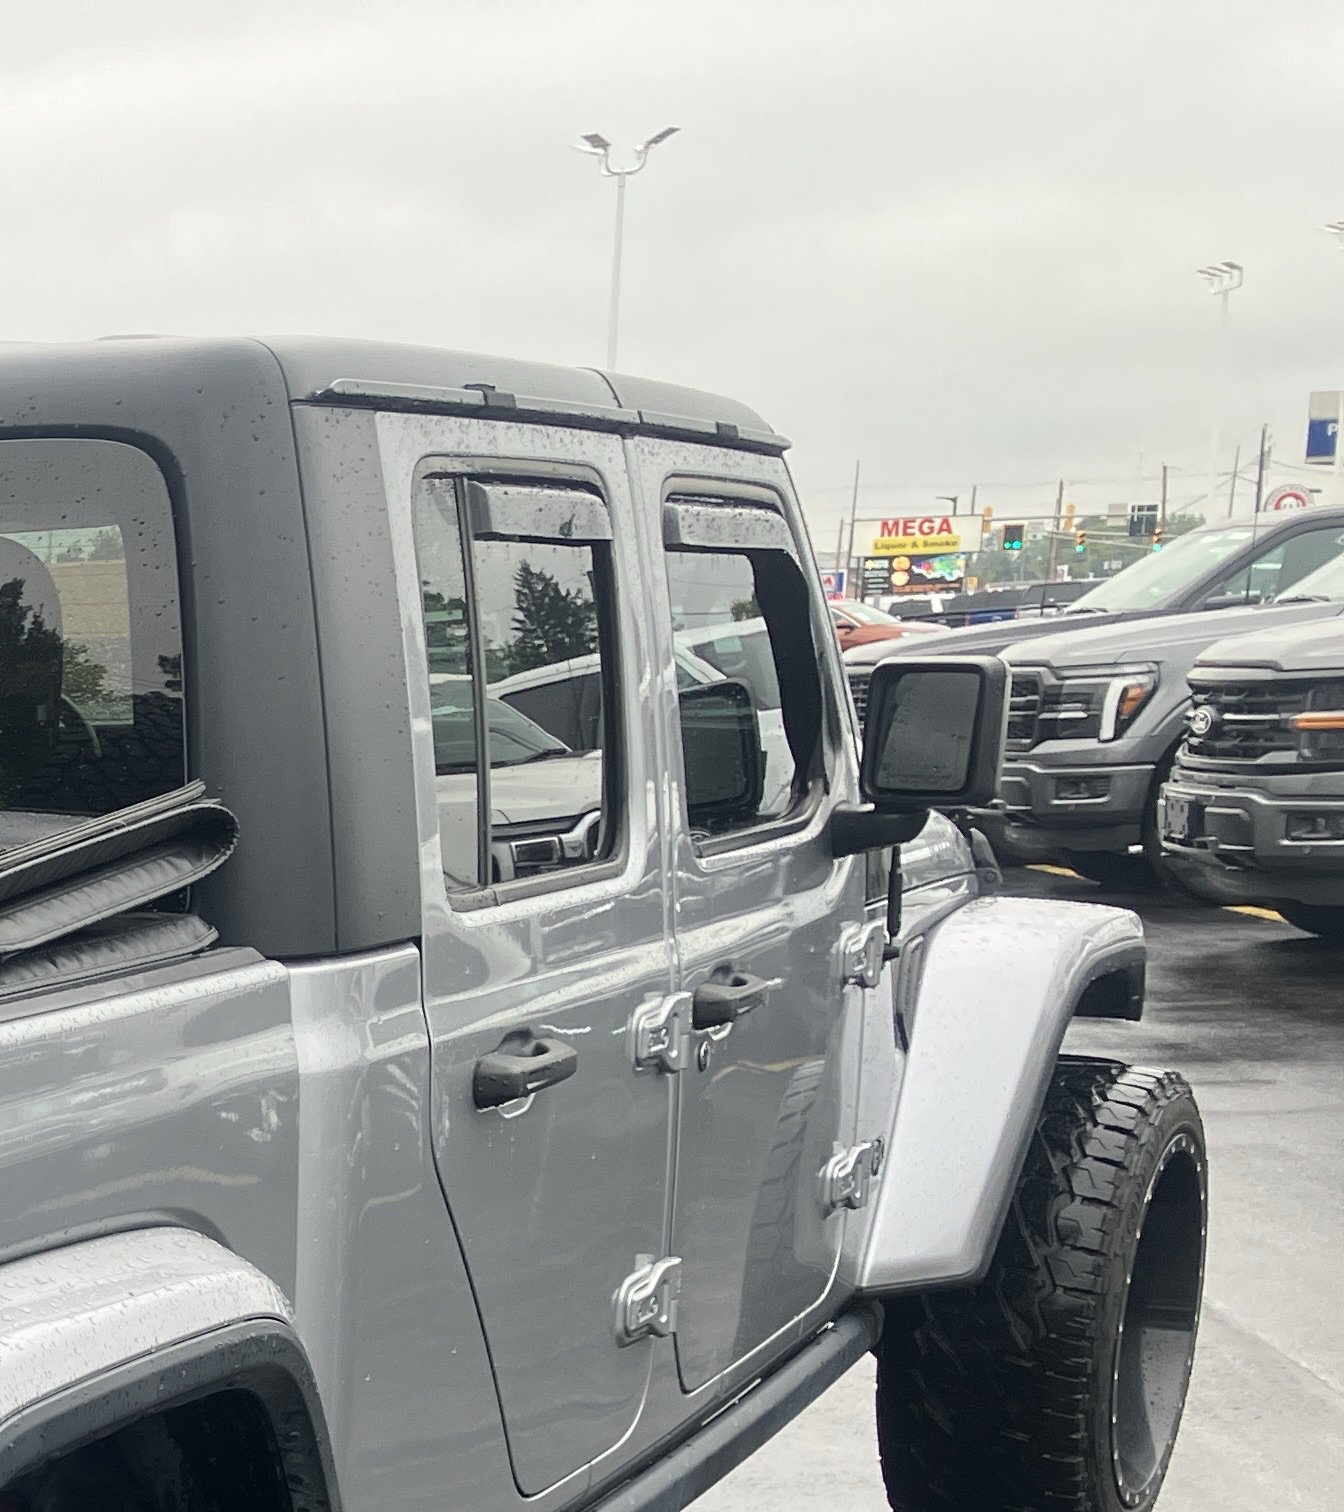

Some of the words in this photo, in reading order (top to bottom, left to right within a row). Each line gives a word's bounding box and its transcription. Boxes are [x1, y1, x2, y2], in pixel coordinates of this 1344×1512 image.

[880, 518, 953, 538] MEGA
[874, 541, 908, 550] Liquor
[923, 540, 958, 548] Smoke
